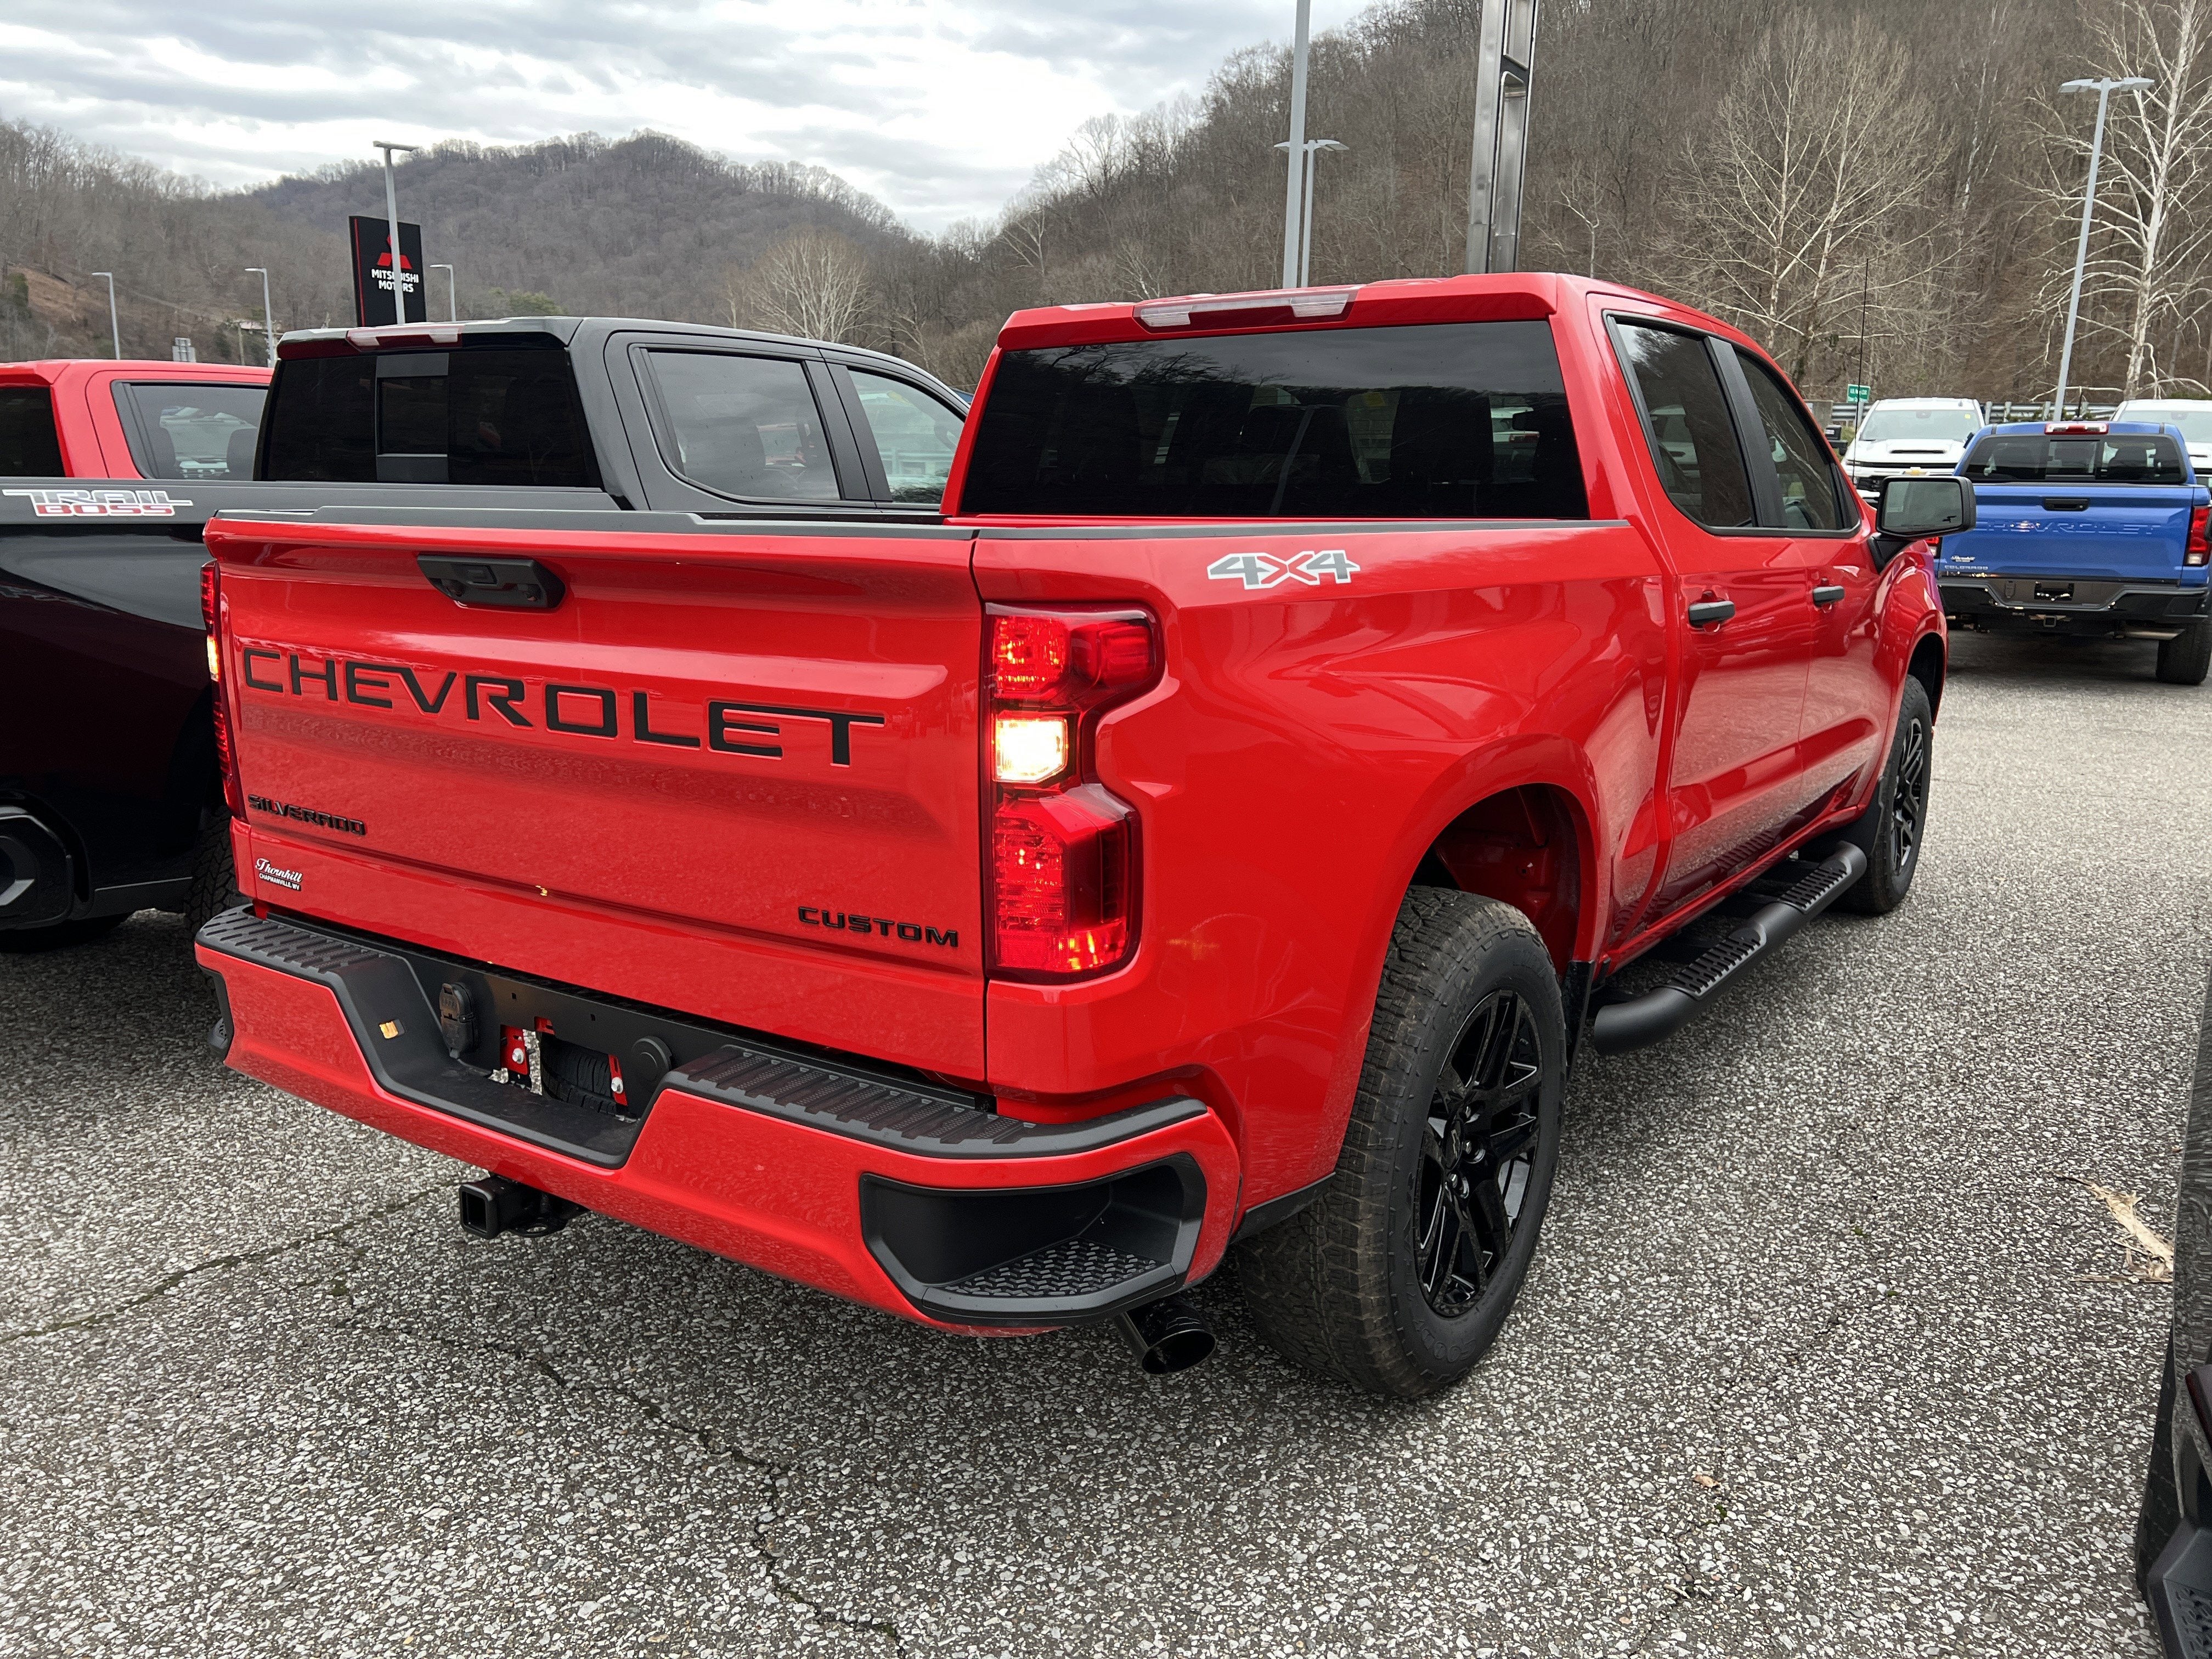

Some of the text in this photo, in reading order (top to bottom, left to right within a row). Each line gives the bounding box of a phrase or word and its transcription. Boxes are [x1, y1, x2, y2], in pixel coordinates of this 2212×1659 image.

[379, 280, 414, 292] MOTRS
[2, 489, 193, 506] TRAIL
[35, 503, 175, 516] BOSS
[244, 648, 885, 766] CHEVROLET
[248, 794, 366, 836] SILVERADO
[255, 857, 303, 882] Thornhill
[798, 906, 958, 947] CUSTOM
